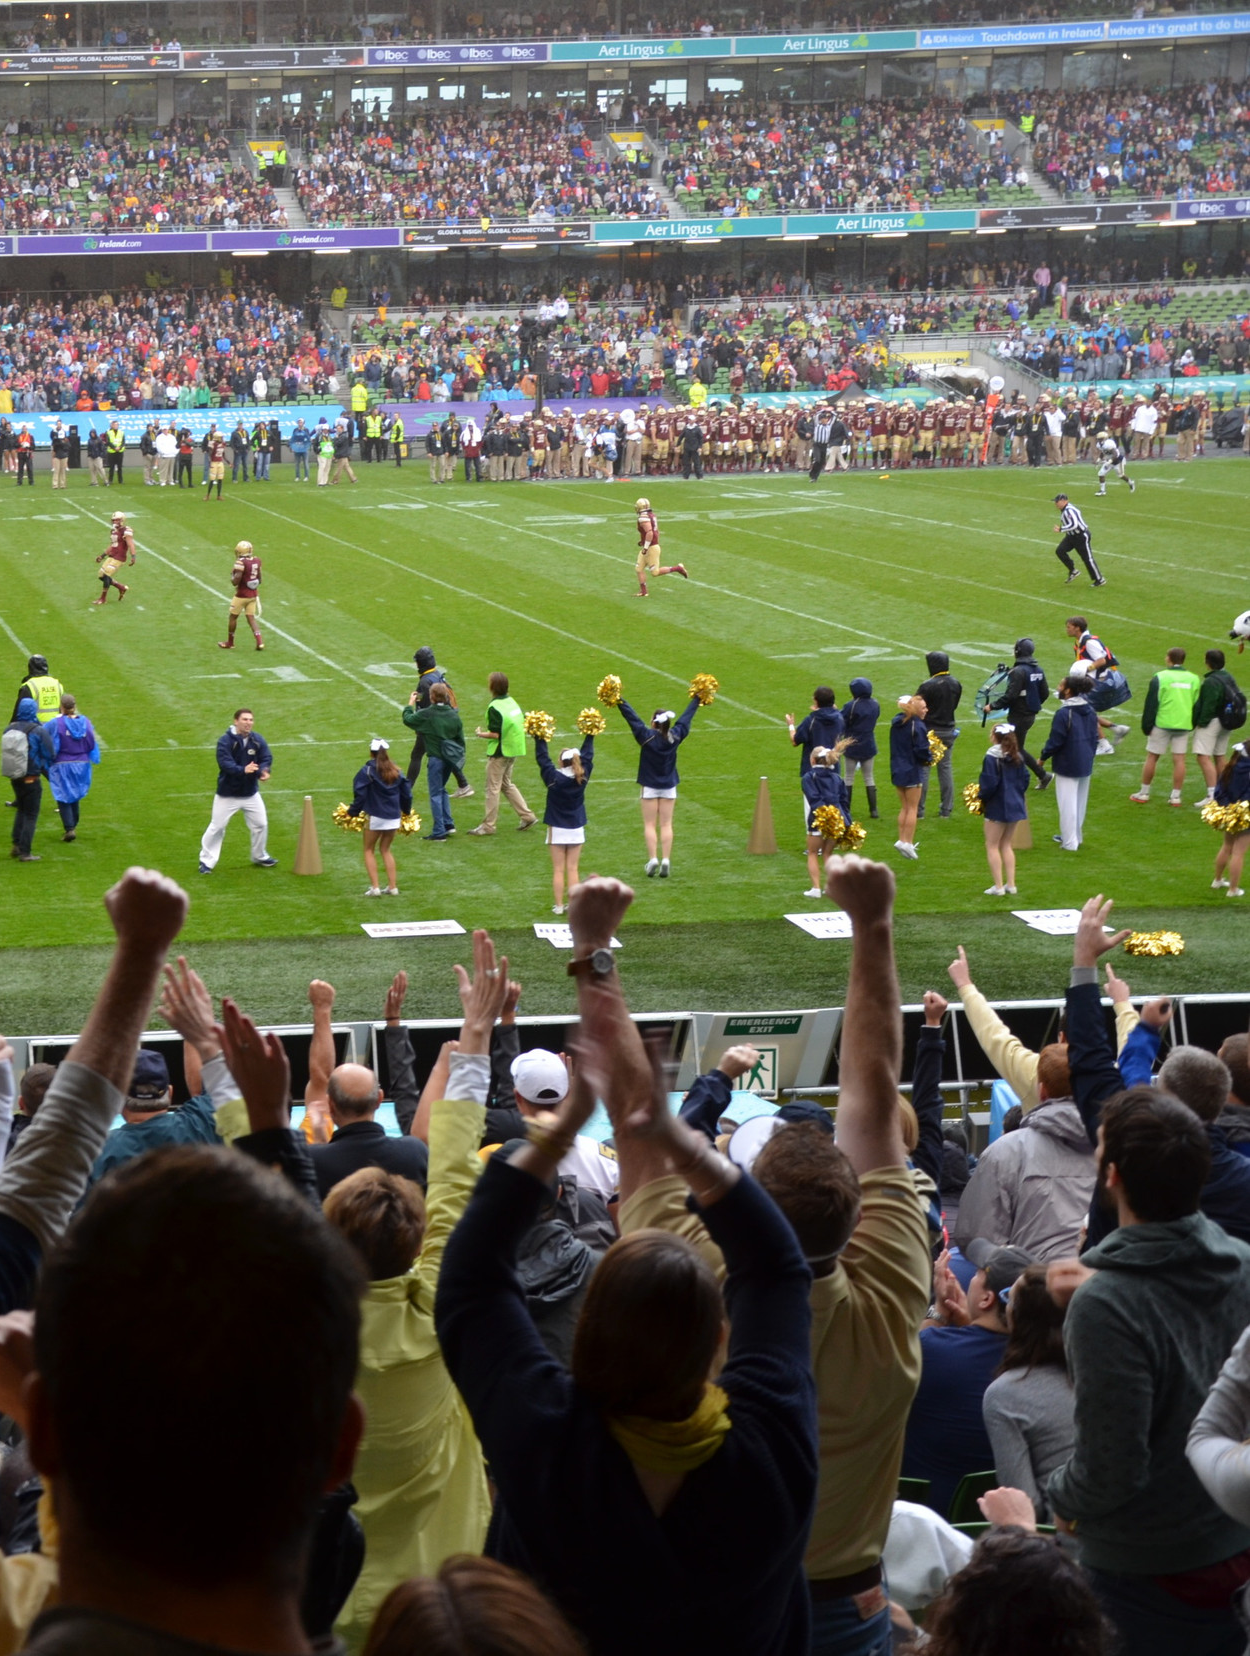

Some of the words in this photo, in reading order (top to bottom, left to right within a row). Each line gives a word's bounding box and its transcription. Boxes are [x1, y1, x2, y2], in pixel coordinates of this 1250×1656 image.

[981, 31, 1045, 42] Touchdown
[1048, 29, 1058, 39] in
[1062, 27, 1104, 39] Ireland,
[1110, 25, 1145, 35] where
[1148, 24, 1164, 34] it's
[1167, 22, 1197, 35] great
[1201, 21, 1212, 31] to
[1215, 20, 1231, 30] do
[783, 39, 805, 51] Aer
[808, 38, 849, 52] Lingus
[599, 45, 620, 56] Aer
[623, 44, 664, 58] Lingus
[836, 218, 859, 230] Aer
[861, 216, 905, 231] Lingus
[645, 224, 666, 236] Aer
[669, 223, 713, 238] Lingus
[99, 239, 142, 248] ireland.com
[292, 235, 335, 244] ireland.com
[208, 409, 292, 417] Cathrach
[729, 1017, 799, 1026] EMERGENCY
[748, 1026, 774, 1034] EXIT
